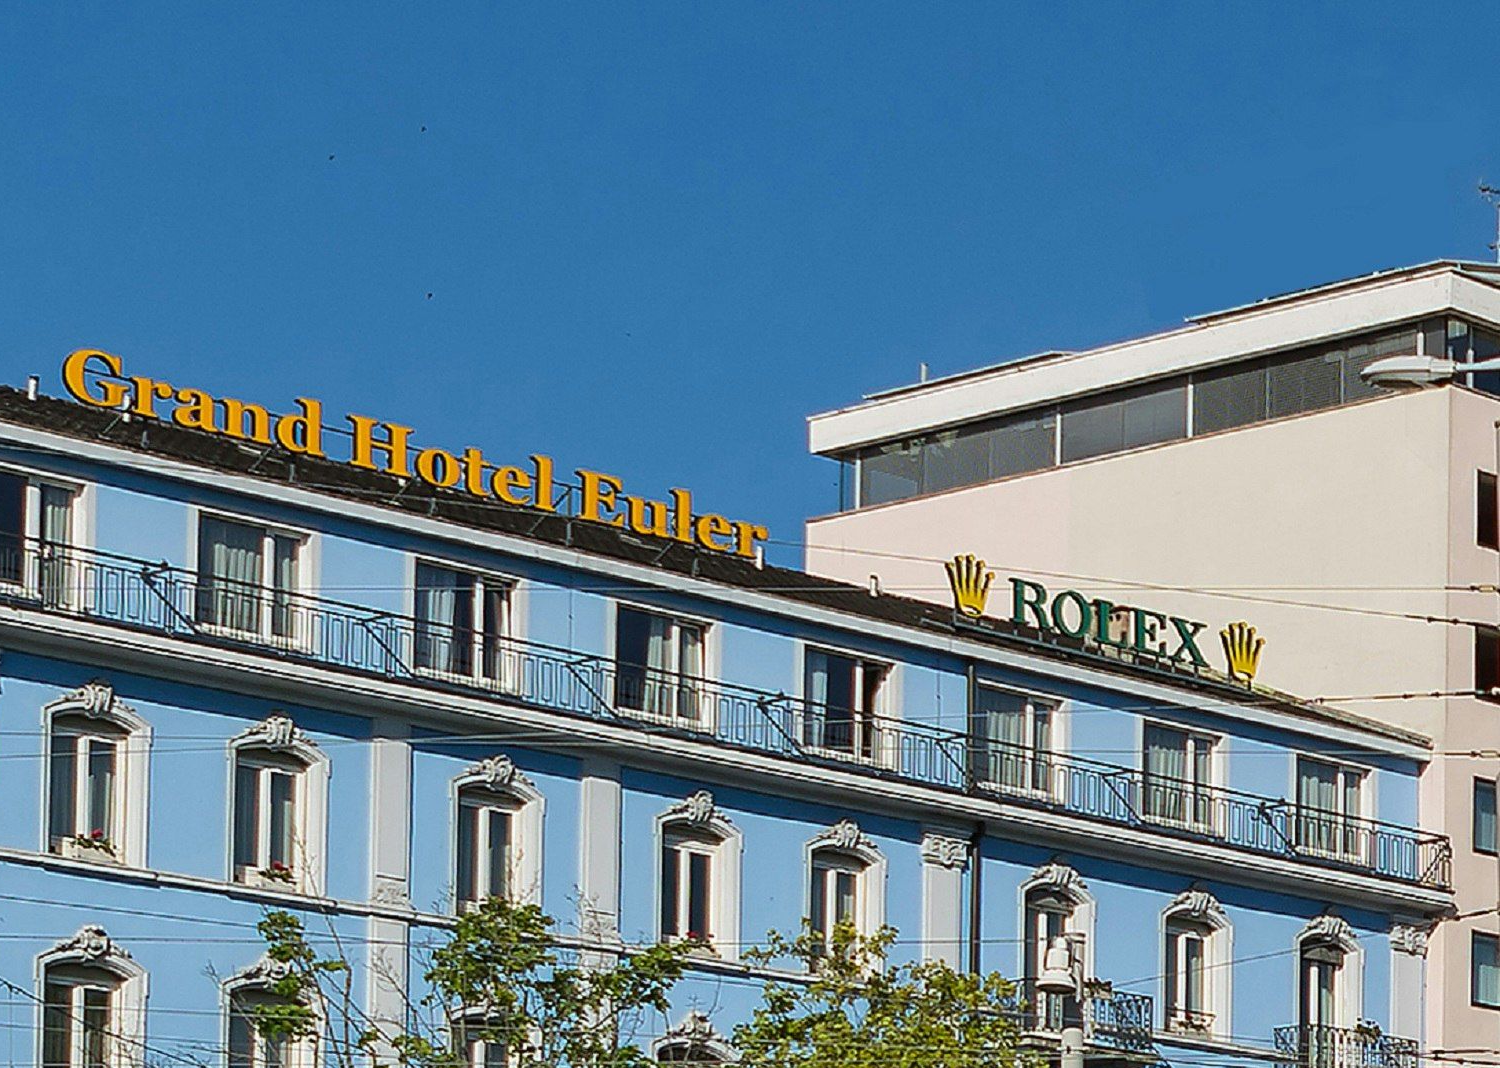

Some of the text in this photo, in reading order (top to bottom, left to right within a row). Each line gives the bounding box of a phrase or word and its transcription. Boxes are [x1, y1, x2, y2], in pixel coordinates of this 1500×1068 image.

[62, 348, 770, 560] Grand Hotel Euler
[1009, 577, 1209, 668] ROLEX
